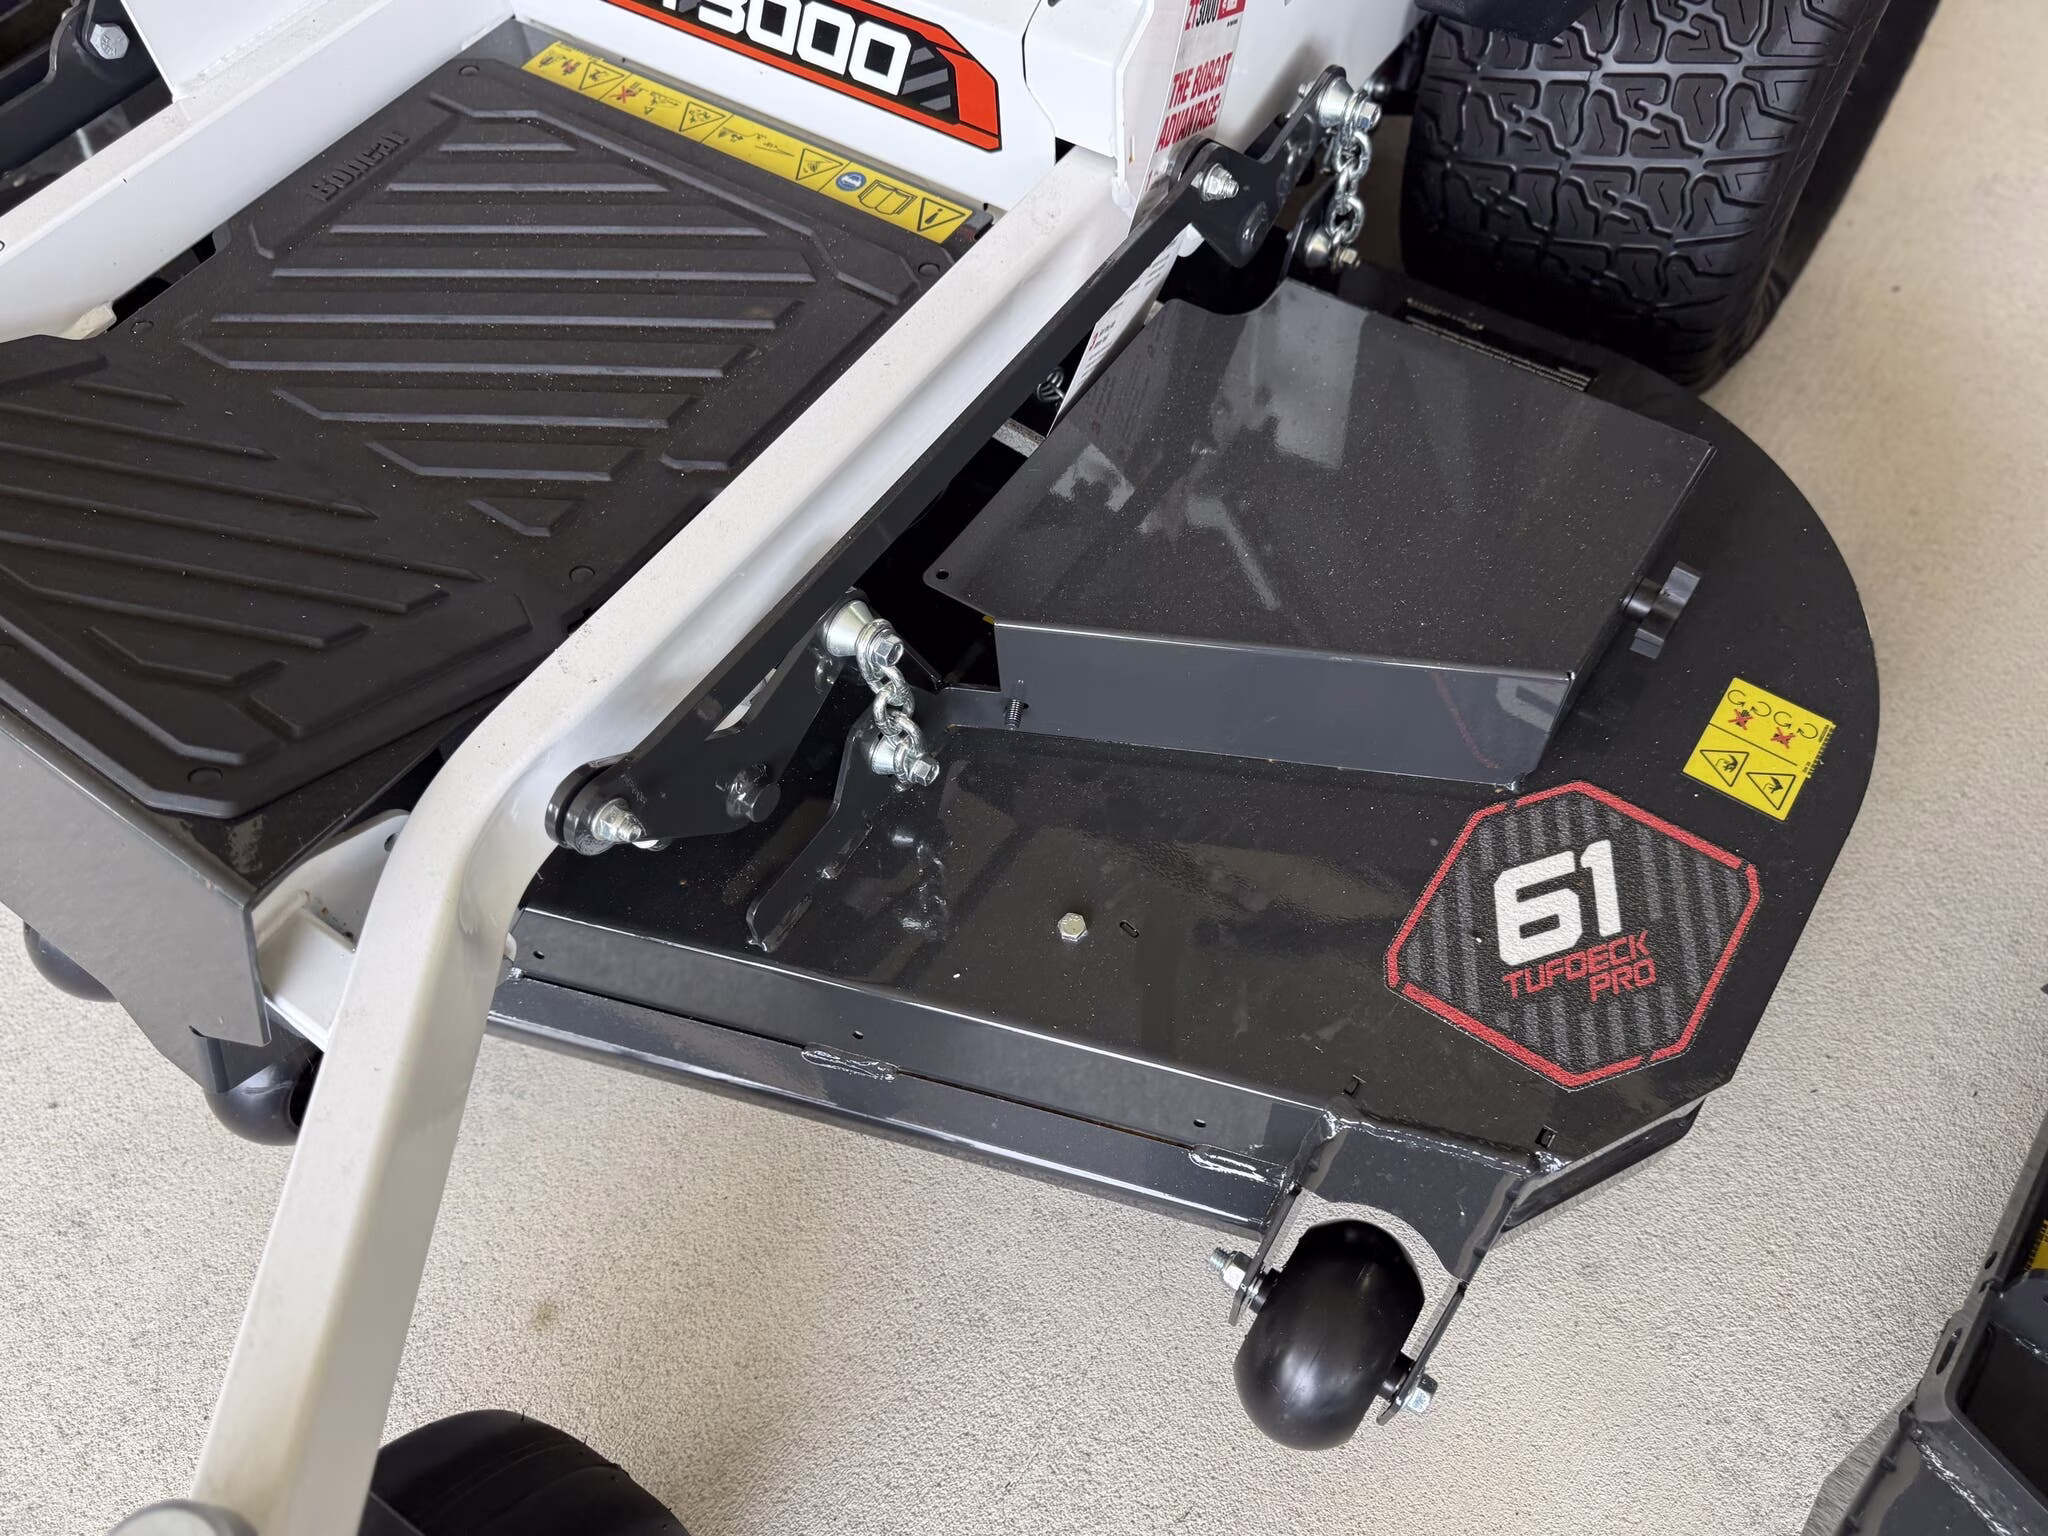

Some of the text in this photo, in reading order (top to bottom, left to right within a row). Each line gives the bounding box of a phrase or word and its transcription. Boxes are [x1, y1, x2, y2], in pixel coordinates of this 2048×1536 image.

[662, 0, 911, 96] 3000
[1168, 51, 1233, 110] THE BOBCAT
[1493, 839, 1622, 966] 61
[1502, 929, 1651, 999] TUFDECK
[1589, 957, 1657, 1003] PRO
